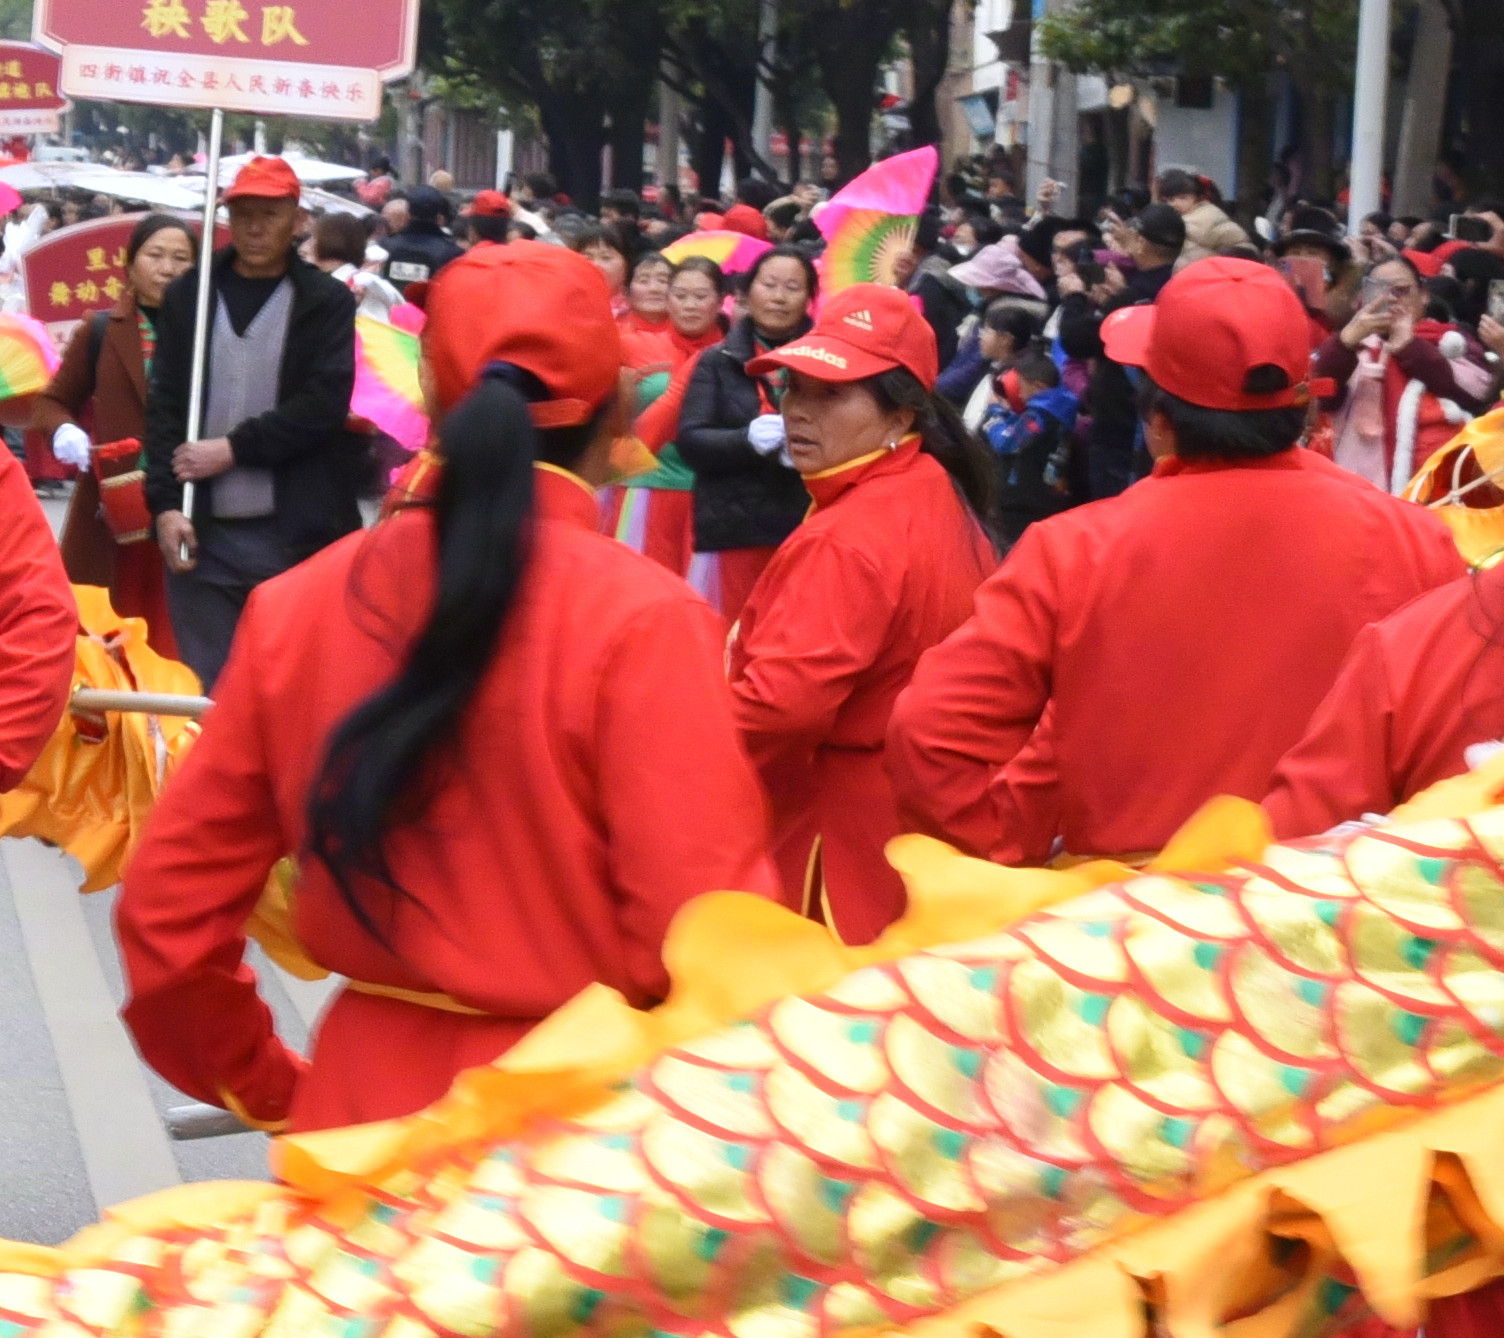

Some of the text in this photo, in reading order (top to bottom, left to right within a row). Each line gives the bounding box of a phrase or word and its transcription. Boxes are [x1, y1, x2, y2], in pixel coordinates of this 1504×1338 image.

[78, 63, 366, 102] 四街镇祝全县人民新春快乐
[777, 345, 848, 370] adidas
